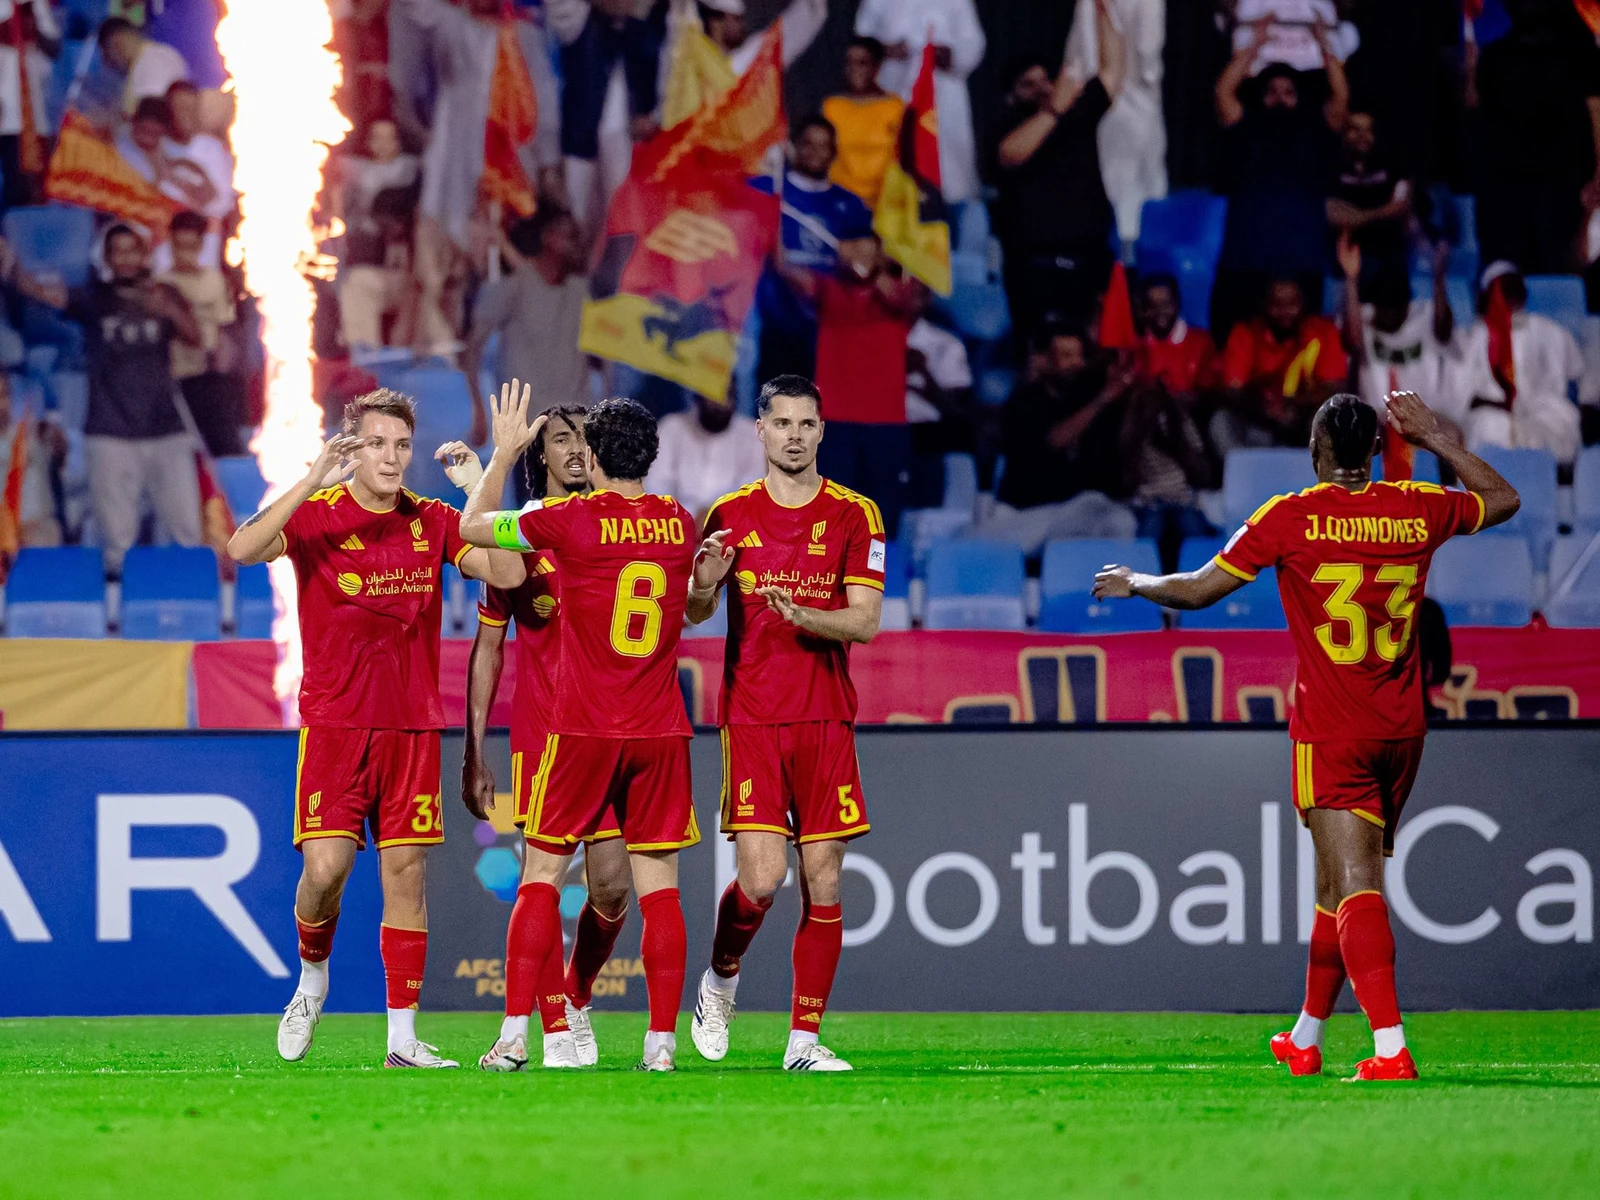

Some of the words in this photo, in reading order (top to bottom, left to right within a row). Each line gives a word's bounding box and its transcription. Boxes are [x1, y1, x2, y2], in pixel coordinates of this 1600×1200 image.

[600, 517, 685, 545] NACHO
[1304, 514, 1429, 544] J.QUINONES
[366, 583, 399, 596] Aloula
[610, 560, 667, 658] 6
[1310, 563, 1419, 665] 33
[838, 784, 860, 825] 5
[1384, 804, 1594, 944] Ca
[455, 959, 502, 978] AFC
[798, 995, 824, 1008] 1935
